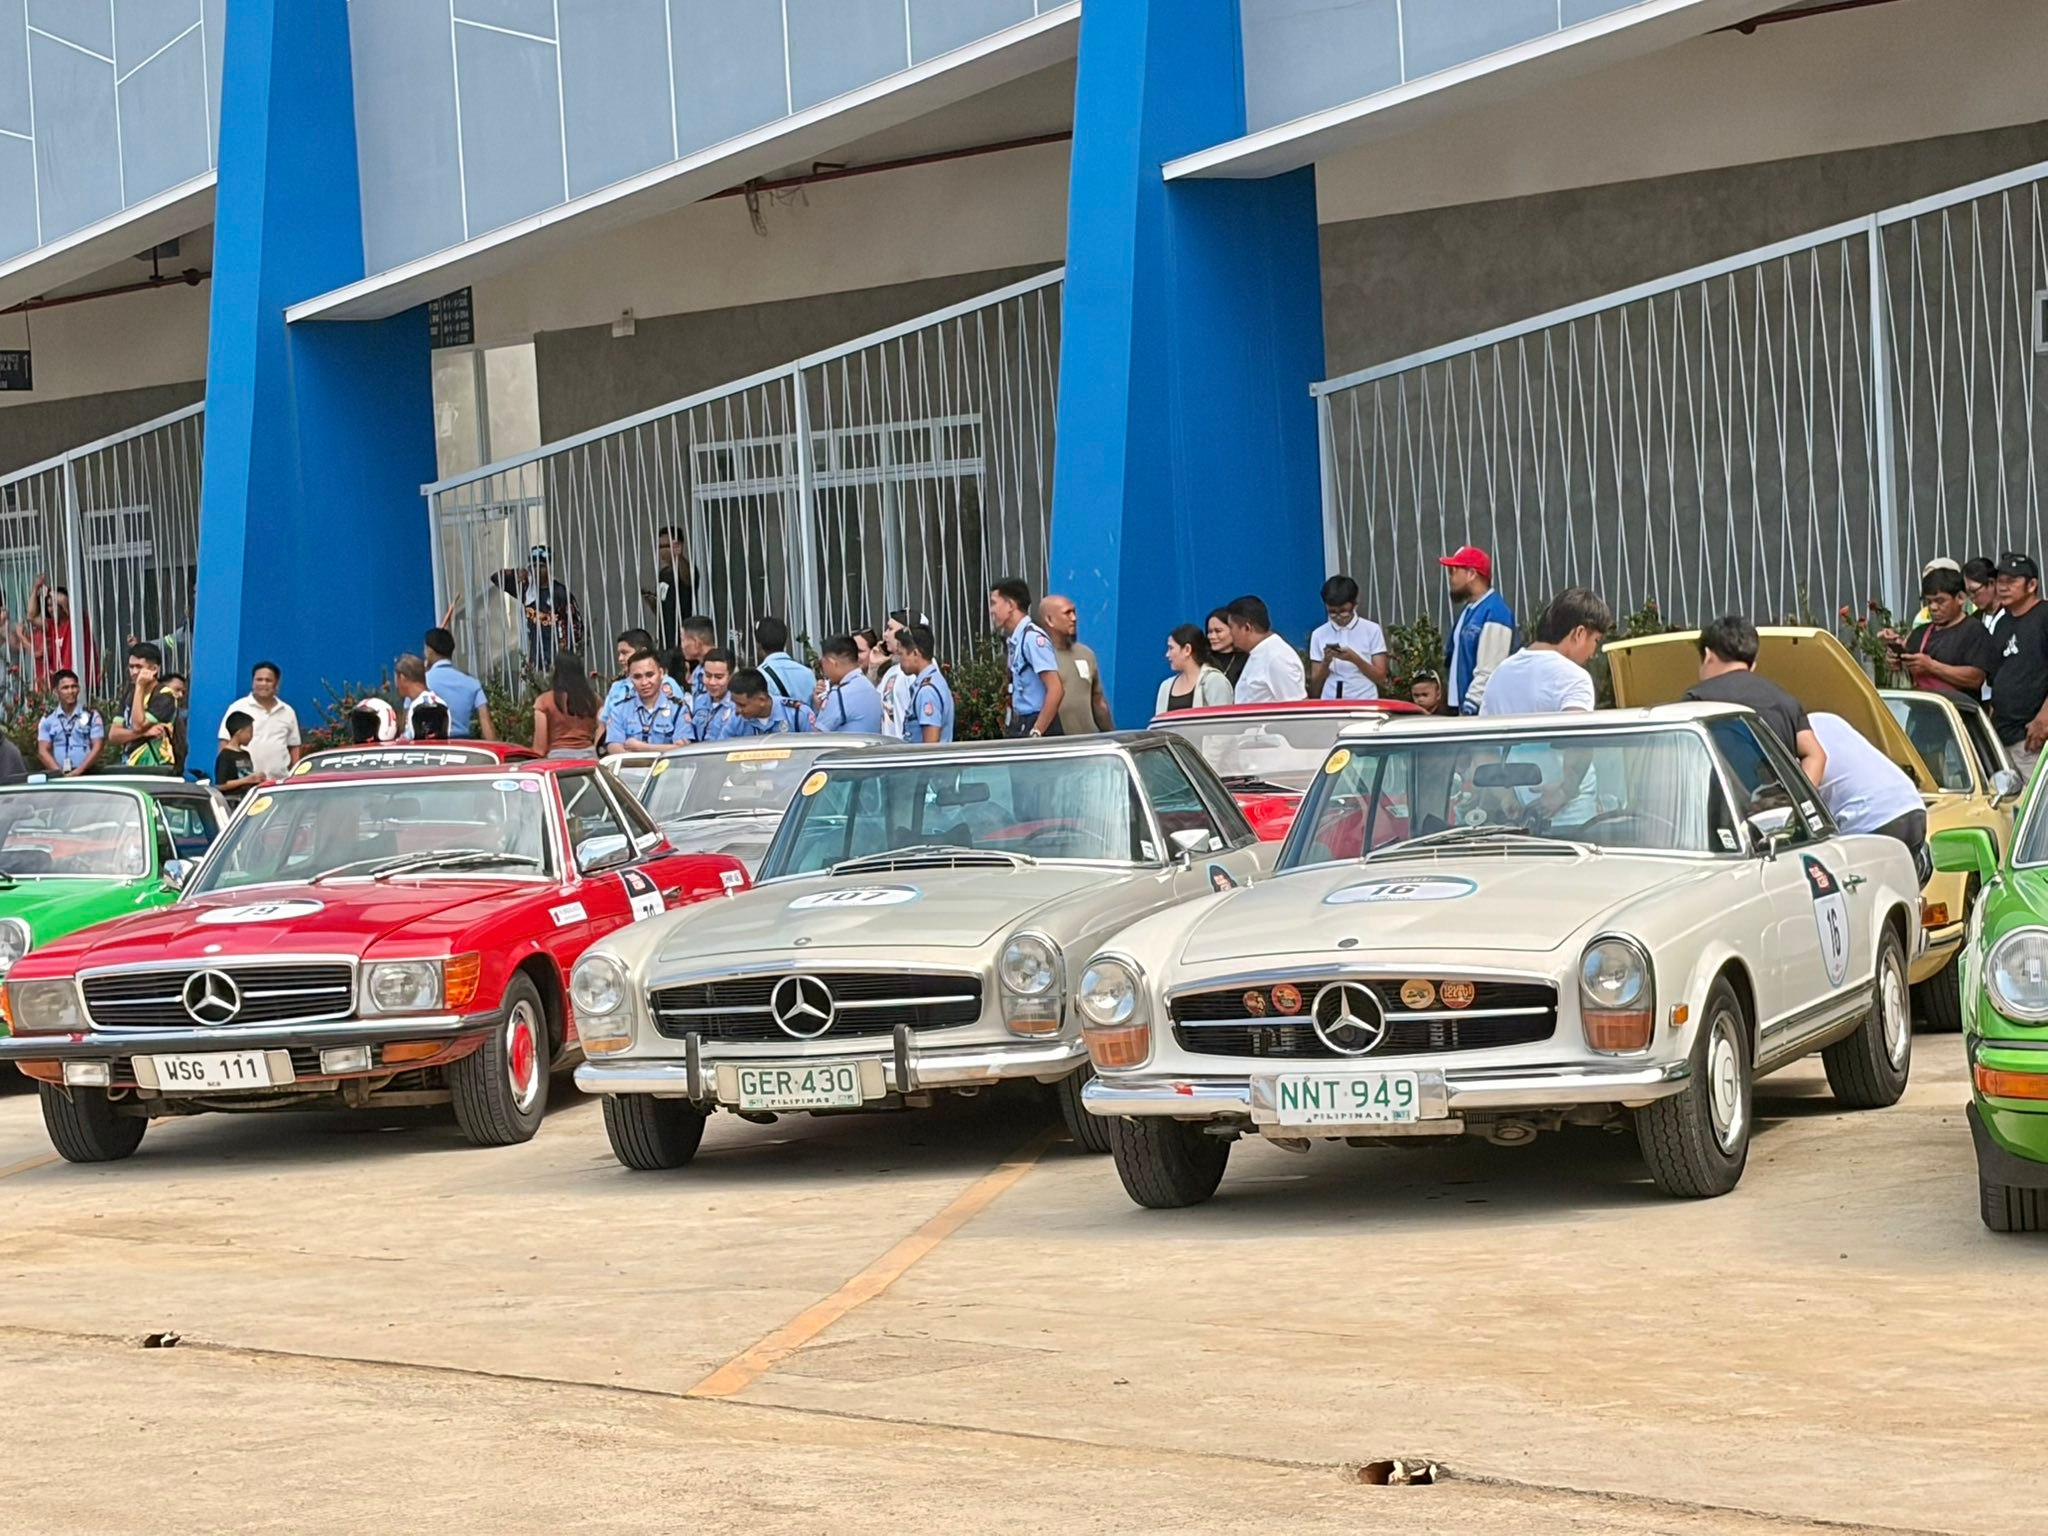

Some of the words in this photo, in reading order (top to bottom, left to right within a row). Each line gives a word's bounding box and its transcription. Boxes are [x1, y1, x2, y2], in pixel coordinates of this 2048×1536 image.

[811, 891, 889, 904] 707
[1371, 884, 1421, 896] 16
[1826, 907, 1842, 958] 16
[164, 1060, 205, 1081] WSG
[219, 1058, 258, 1079] 111
[741, 1071, 793, 1095] GER
[800, 1068, 854, 1093] 430
[771, 1097, 831, 1106] PILIPINAS
[1280, 1081, 1340, 1110] NNT
[1351, 1079, 1413, 1108] 949
[1313, 1112, 1382, 1120] PILIPINAS
